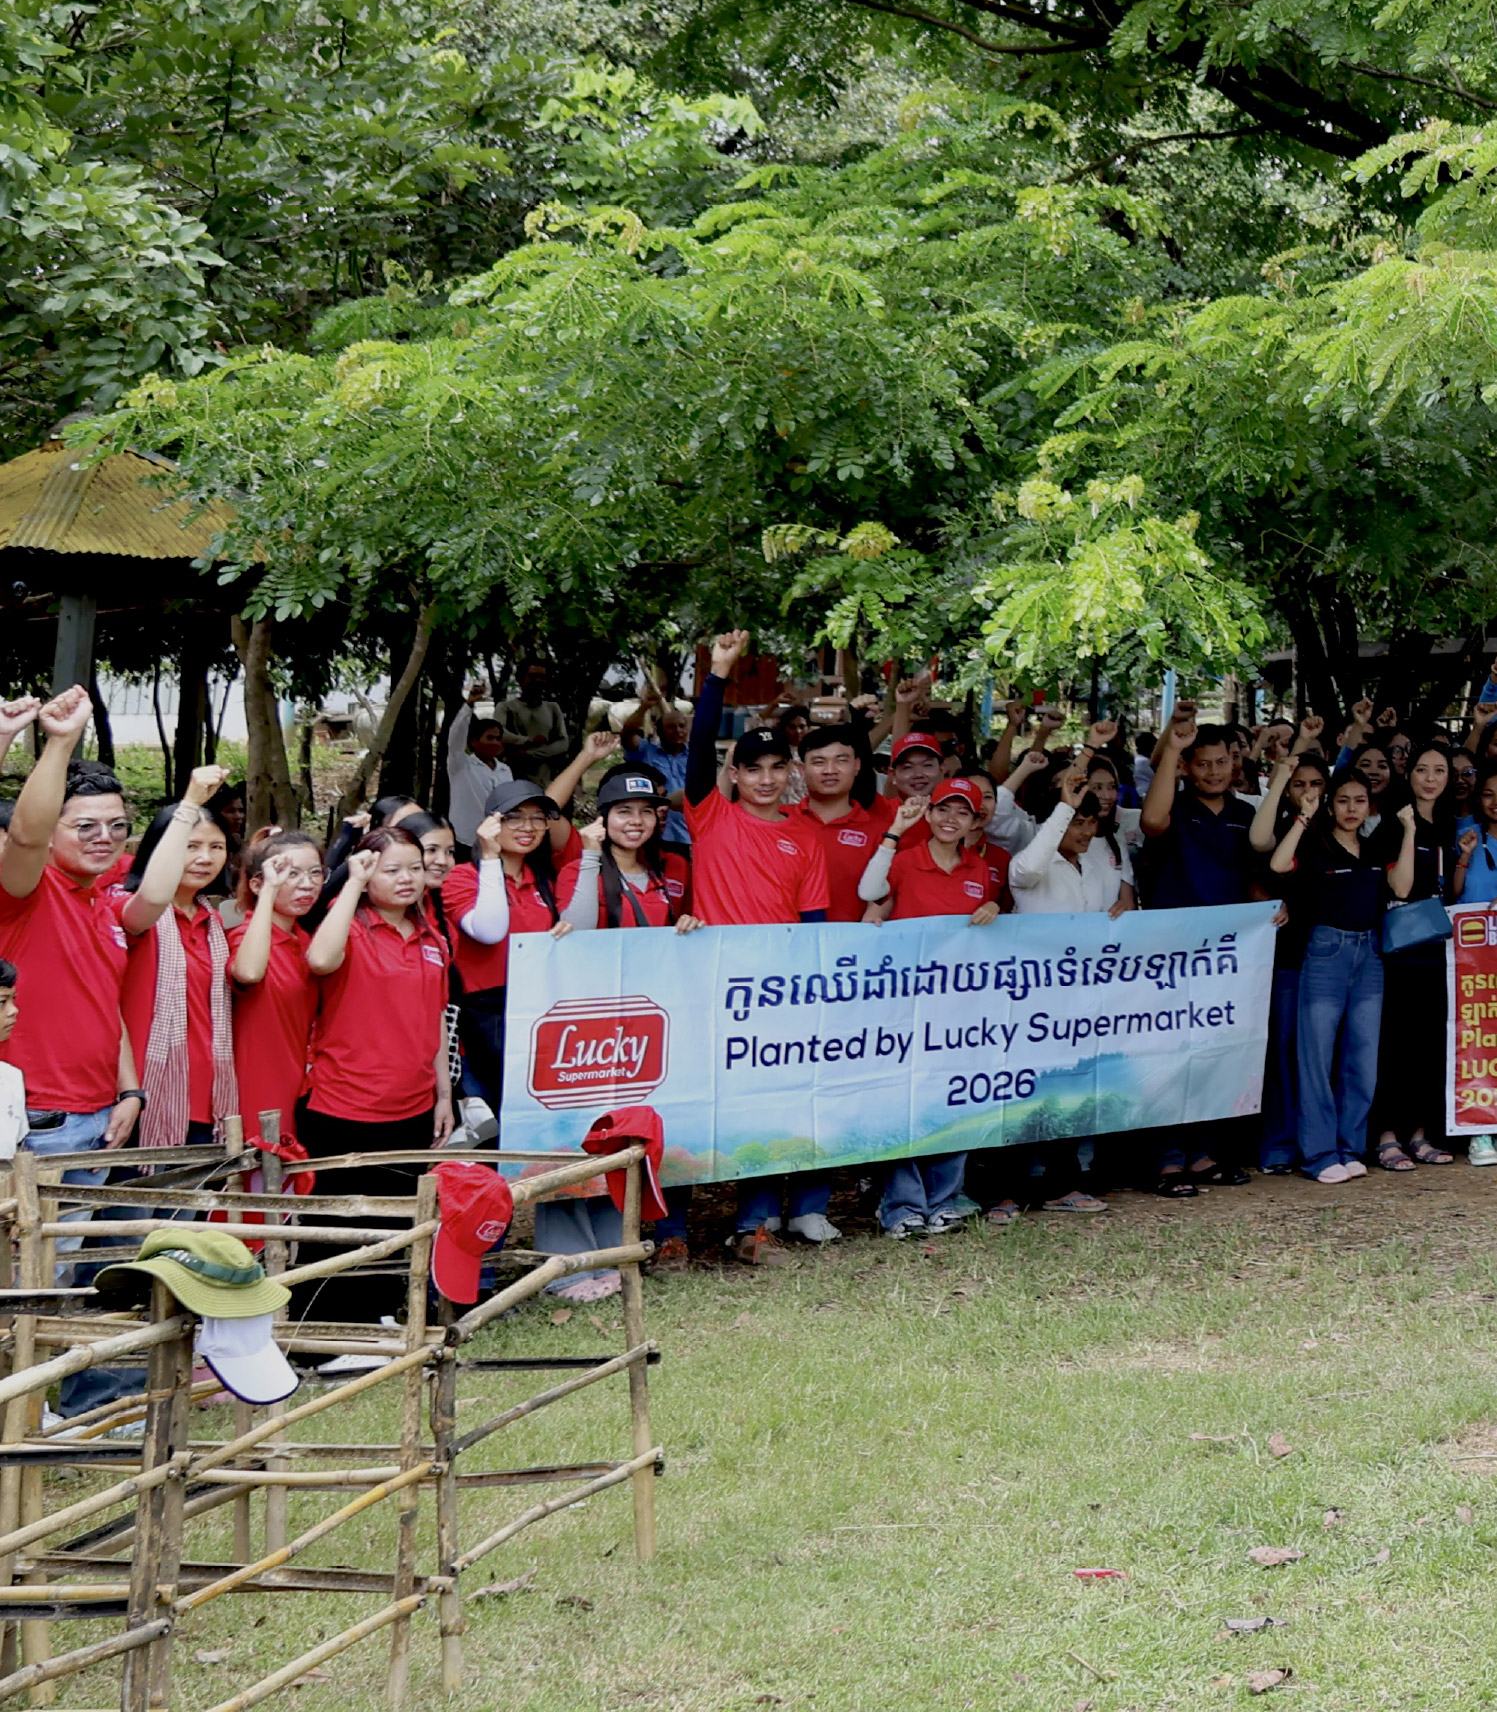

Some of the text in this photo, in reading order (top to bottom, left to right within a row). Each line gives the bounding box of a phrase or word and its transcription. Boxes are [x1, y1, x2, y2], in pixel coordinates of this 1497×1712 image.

[550, 1025, 649, 1078] Lucky
[726, 1000, 1235, 1070] Planted by Lucky Supermarket
[557, 1066, 627, 1083] Supermarket
[947, 1068, 1036, 1106] 2026
